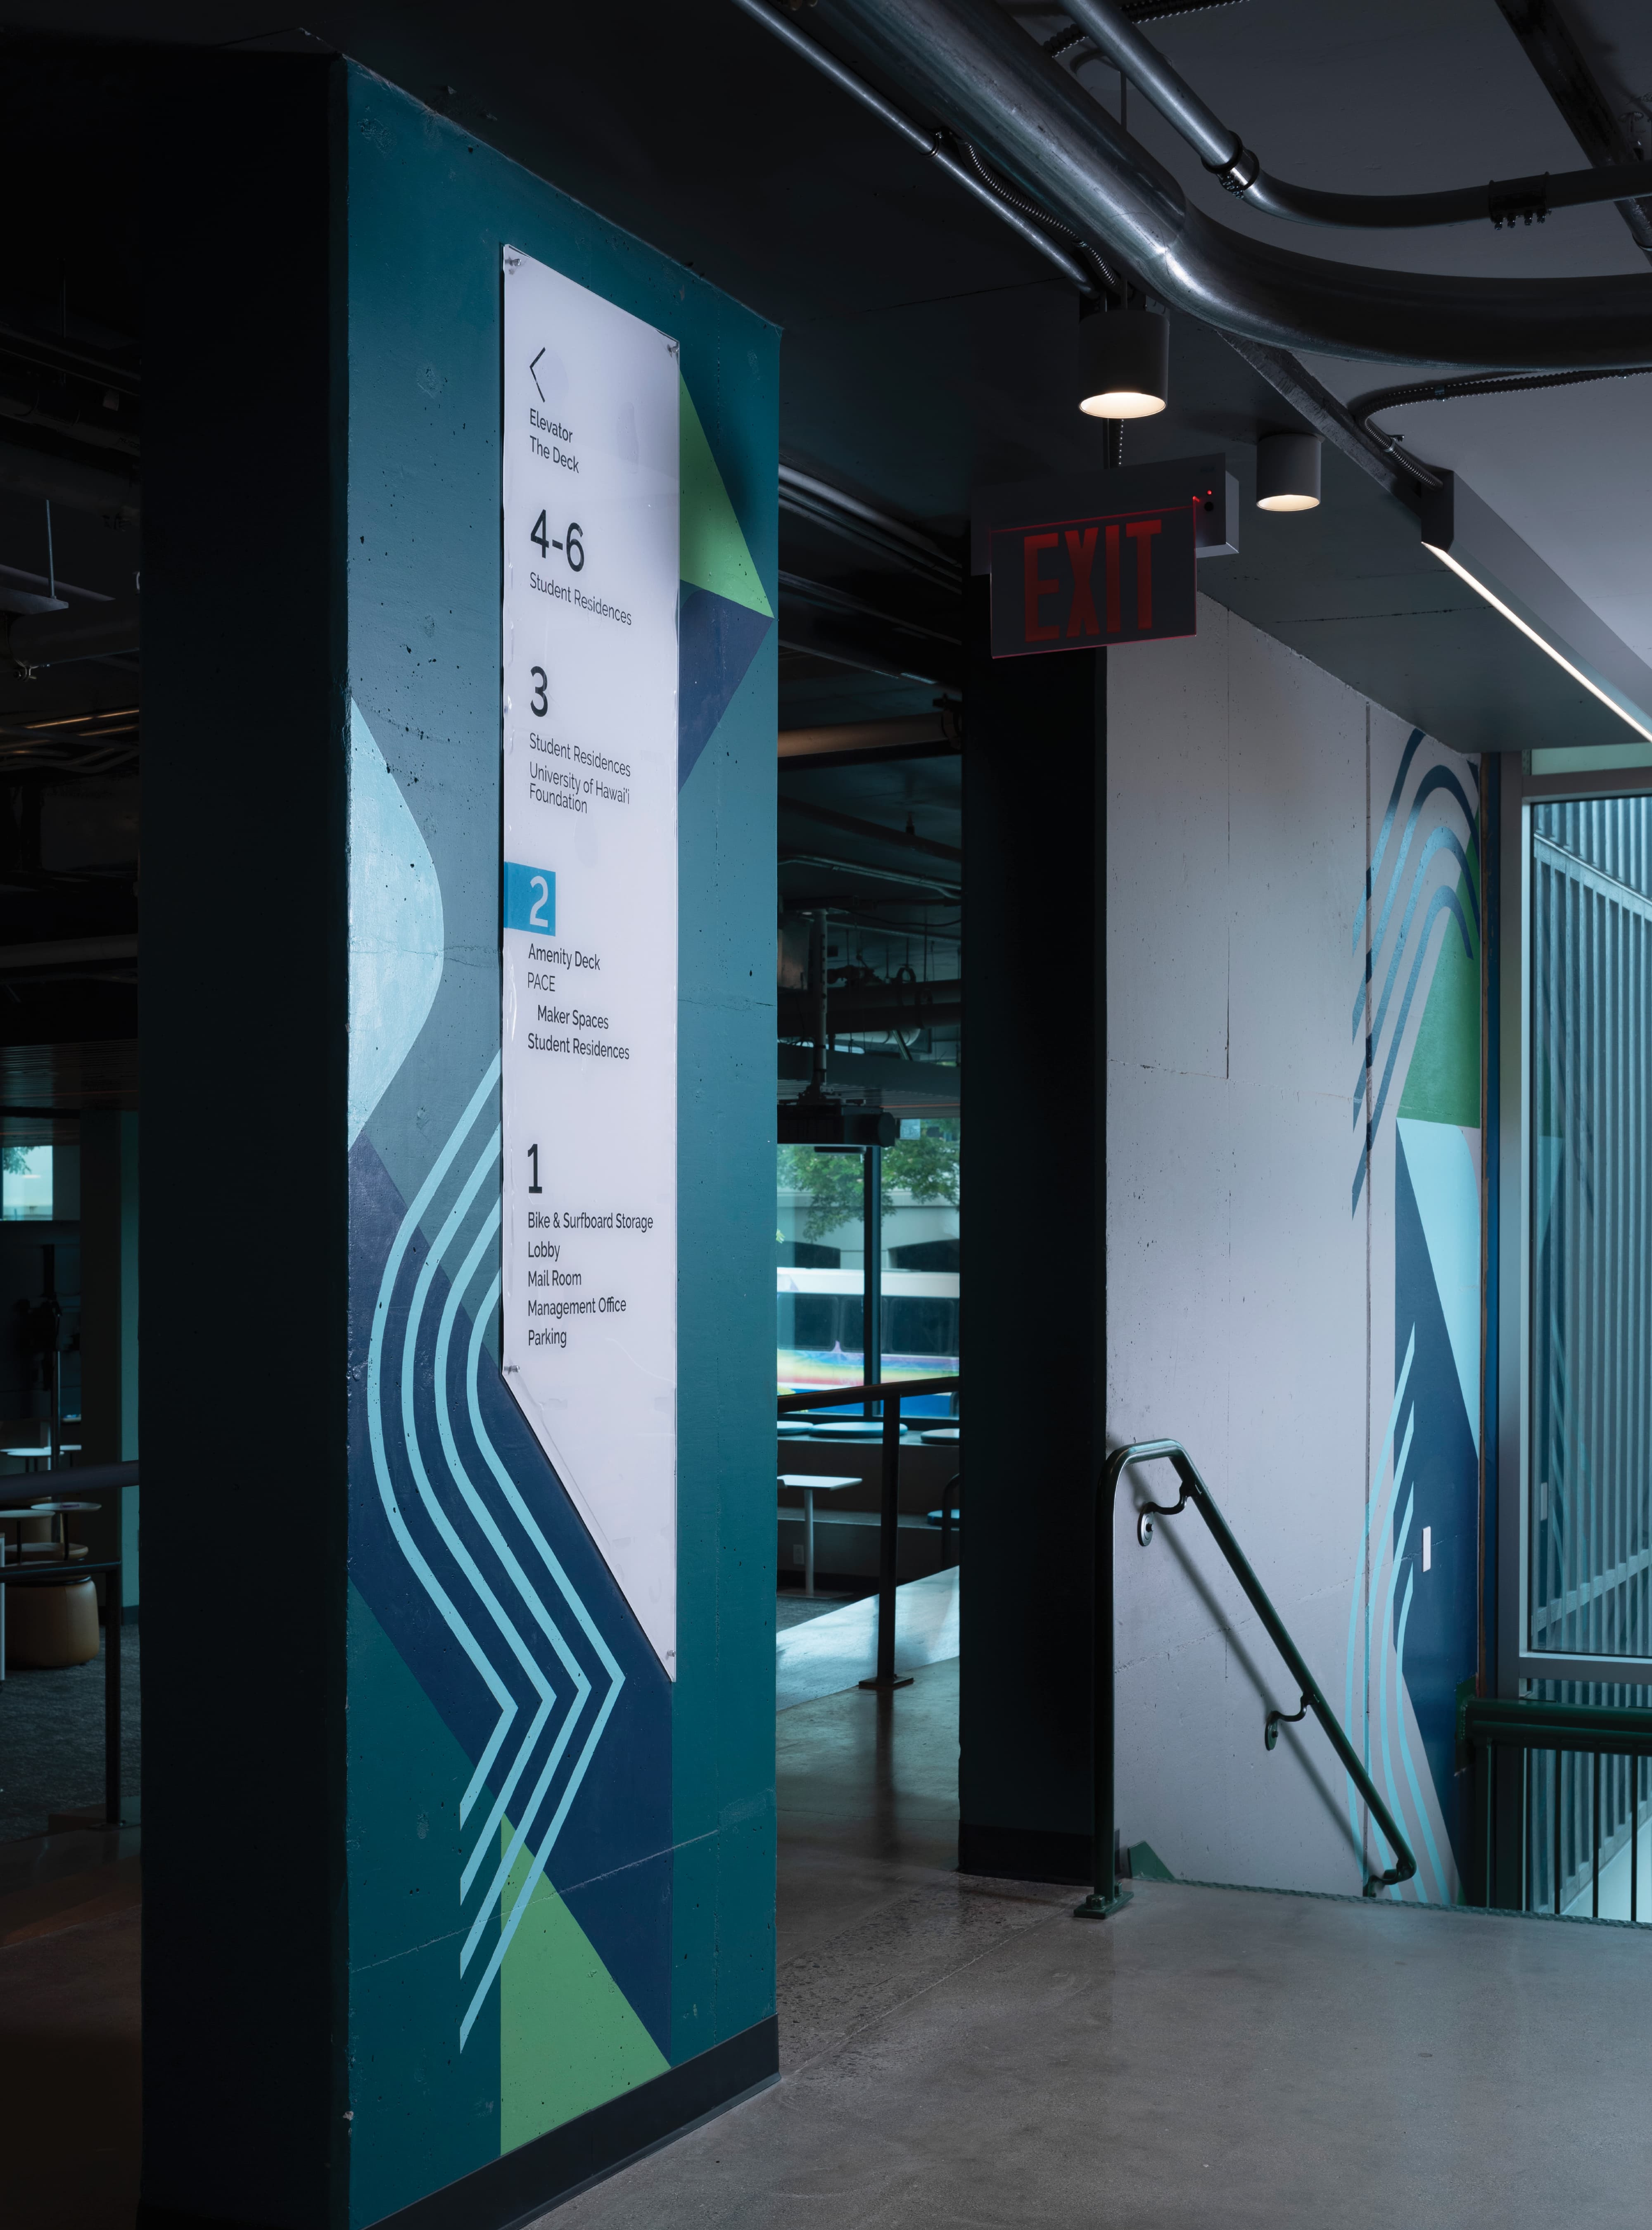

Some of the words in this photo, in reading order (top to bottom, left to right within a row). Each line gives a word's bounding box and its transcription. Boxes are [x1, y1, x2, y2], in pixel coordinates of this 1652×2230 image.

[530, 408, 572, 443] Elevator
[529, 436, 550, 459] The
[553, 446, 579, 473] Deck
[530, 509, 584, 572] 4-6
[1024, 520, 1161, 643] EXIT
[530, 572, 571, 602] Student
[574, 590, 631, 625] Residences
[530, 666, 548, 717] 3
[530, 733, 570, 760] Student
[574, 745, 630, 776] Residences
[530, 762, 581, 795] University
[583, 779, 593, 793] of
[530, 784, 587, 813] Foundation
[530, 876, 548, 927] 2
[529, 944, 572, 970] Amenity
[575, 951, 600, 970] Deck
[528, 973, 555, 992] PACE
[538, 1005, 570, 1024] Maker
[572, 1010, 608, 1030] Spaces
[528, 1033, 570, 1053] Student
[573, 1038, 629, 1060] Residences
[528, 1144, 542, 1193] 1
[528, 1212, 550, 1228] Bike
[553, 1212, 560, 1228] &
[563, 1212, 612, 1228] Surfboard
[616, 1213, 653, 1232] Storage
[528, 1241, 560, 1261] Lobby
[528, 1270, 550, 1286] Mail
[553, 1270, 582, 1285] Room
[528, 1298, 596, 1319] Management
[598, 1296, 626, 1312] Office
[528, 1329, 567, 1348] Parking
